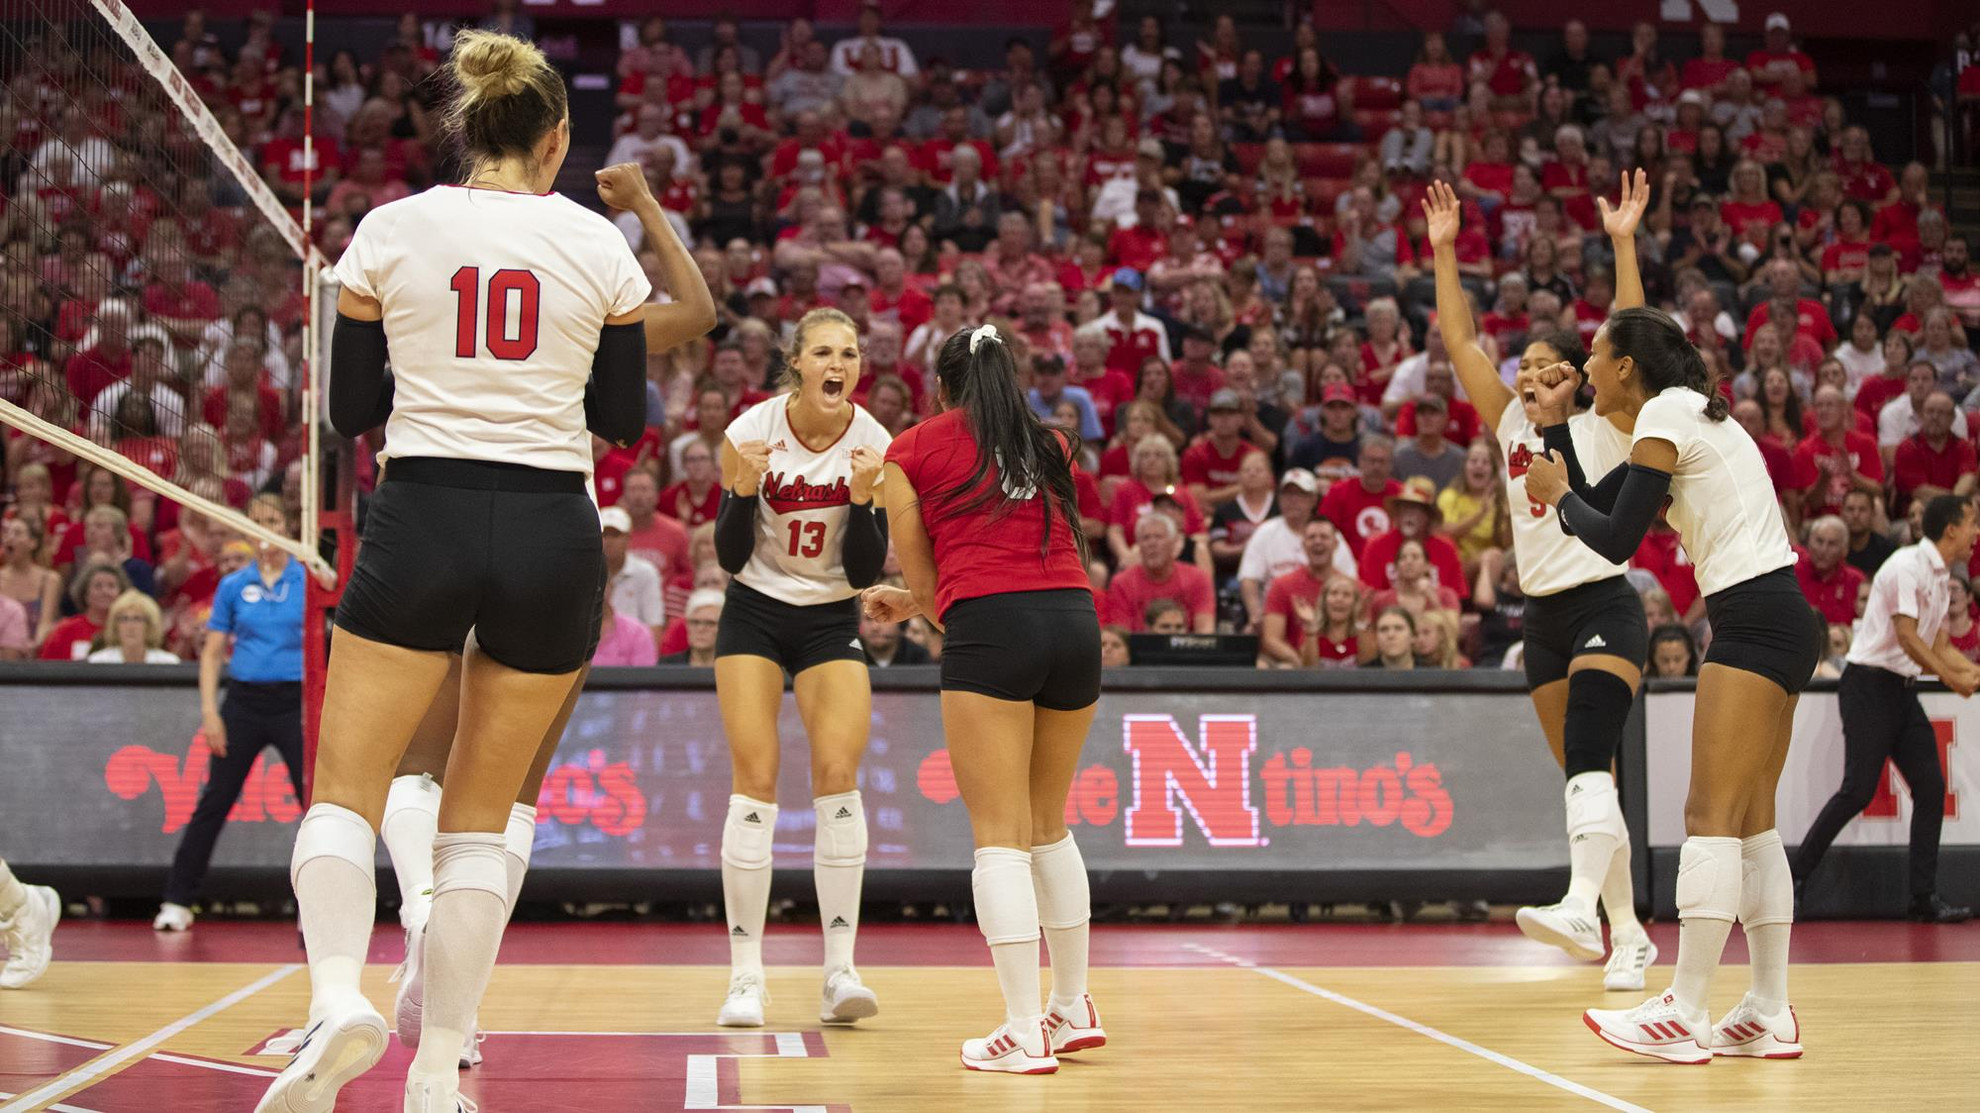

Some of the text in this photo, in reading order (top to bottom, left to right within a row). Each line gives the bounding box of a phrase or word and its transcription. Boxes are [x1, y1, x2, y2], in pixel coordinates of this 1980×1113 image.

[450, 265, 541, 361] 10
[761, 471, 851, 505] Nebrask
[788, 519, 827, 558] 13
[1123, 713, 1261, 847] N
[1260, 747, 1454, 838] tino's
